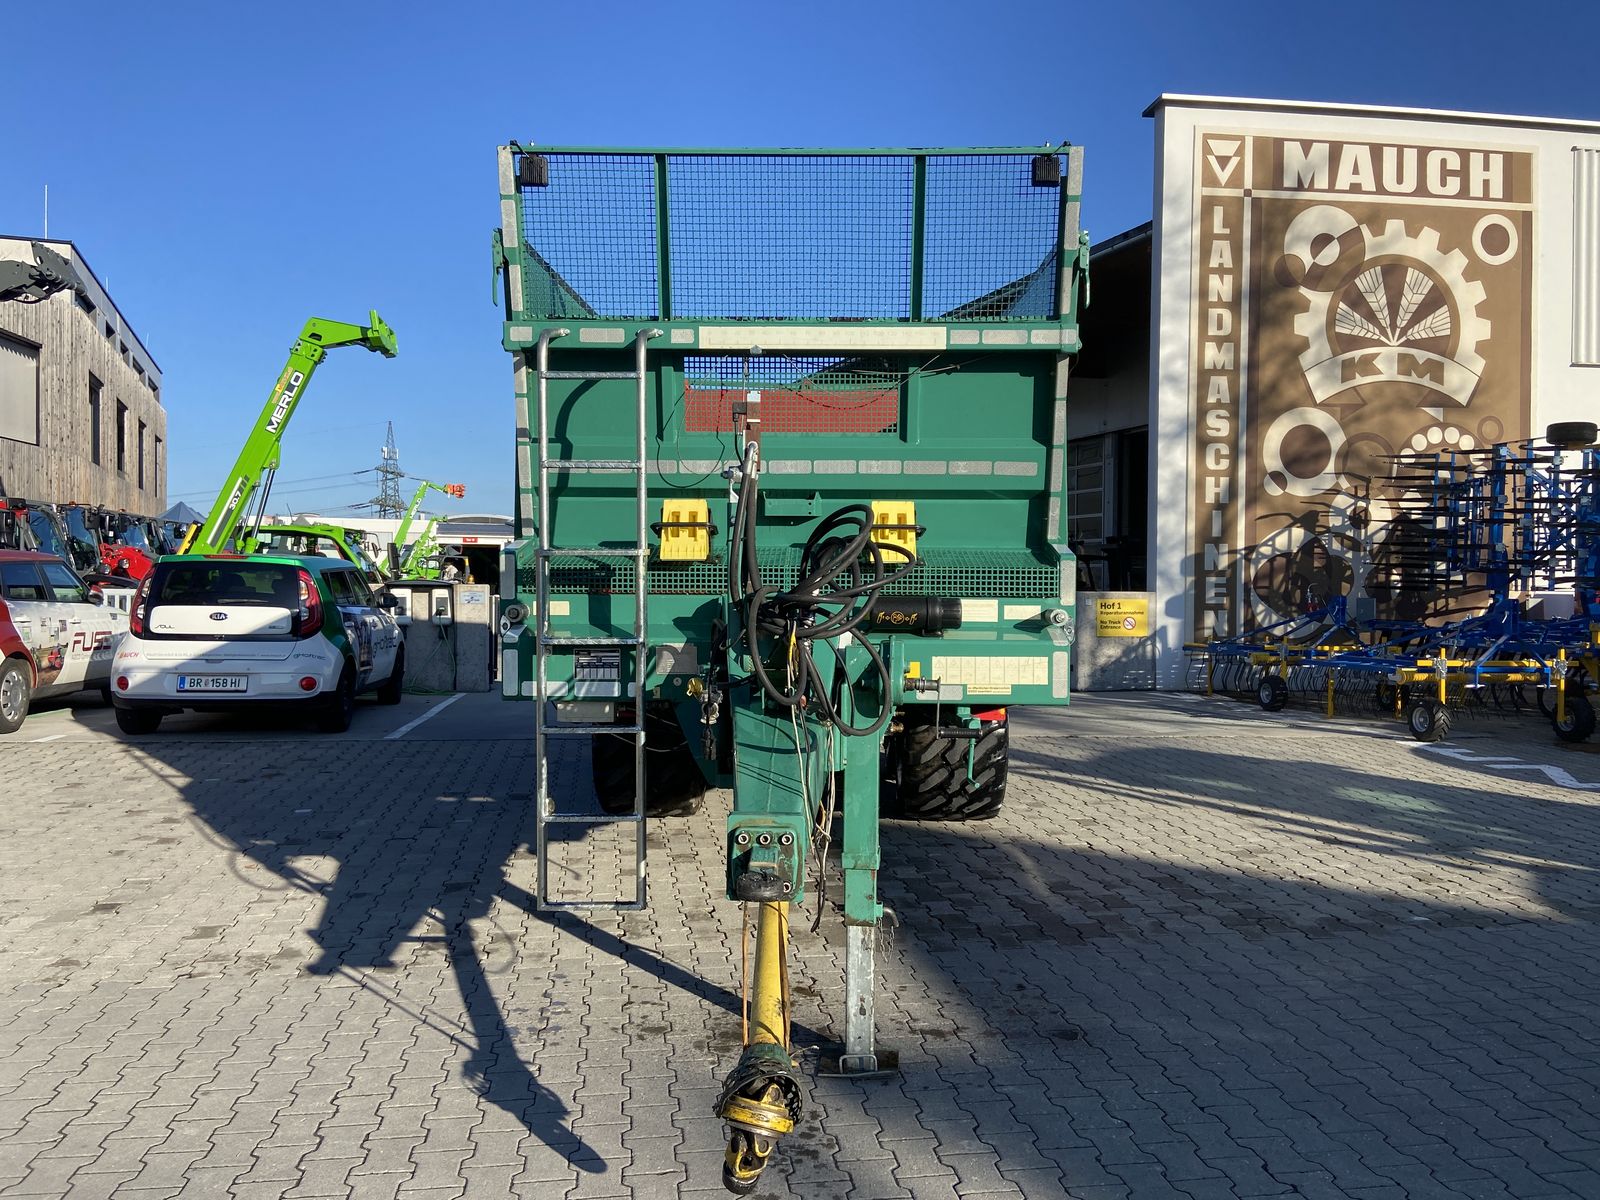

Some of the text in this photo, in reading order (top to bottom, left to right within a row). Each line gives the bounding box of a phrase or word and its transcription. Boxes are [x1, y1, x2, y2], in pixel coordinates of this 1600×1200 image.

[1283, 140, 1504, 199] MAUCH
[1341, 352, 1444, 386] KM
[265, 371, 304, 433] MERLO
[1204, 206, 1235, 637] LANDMASCHINEN
[229, 491, 242, 510] 30.7
[211, 612, 227, 620] KIA
[189, 678, 240, 687] BR 158 HI
